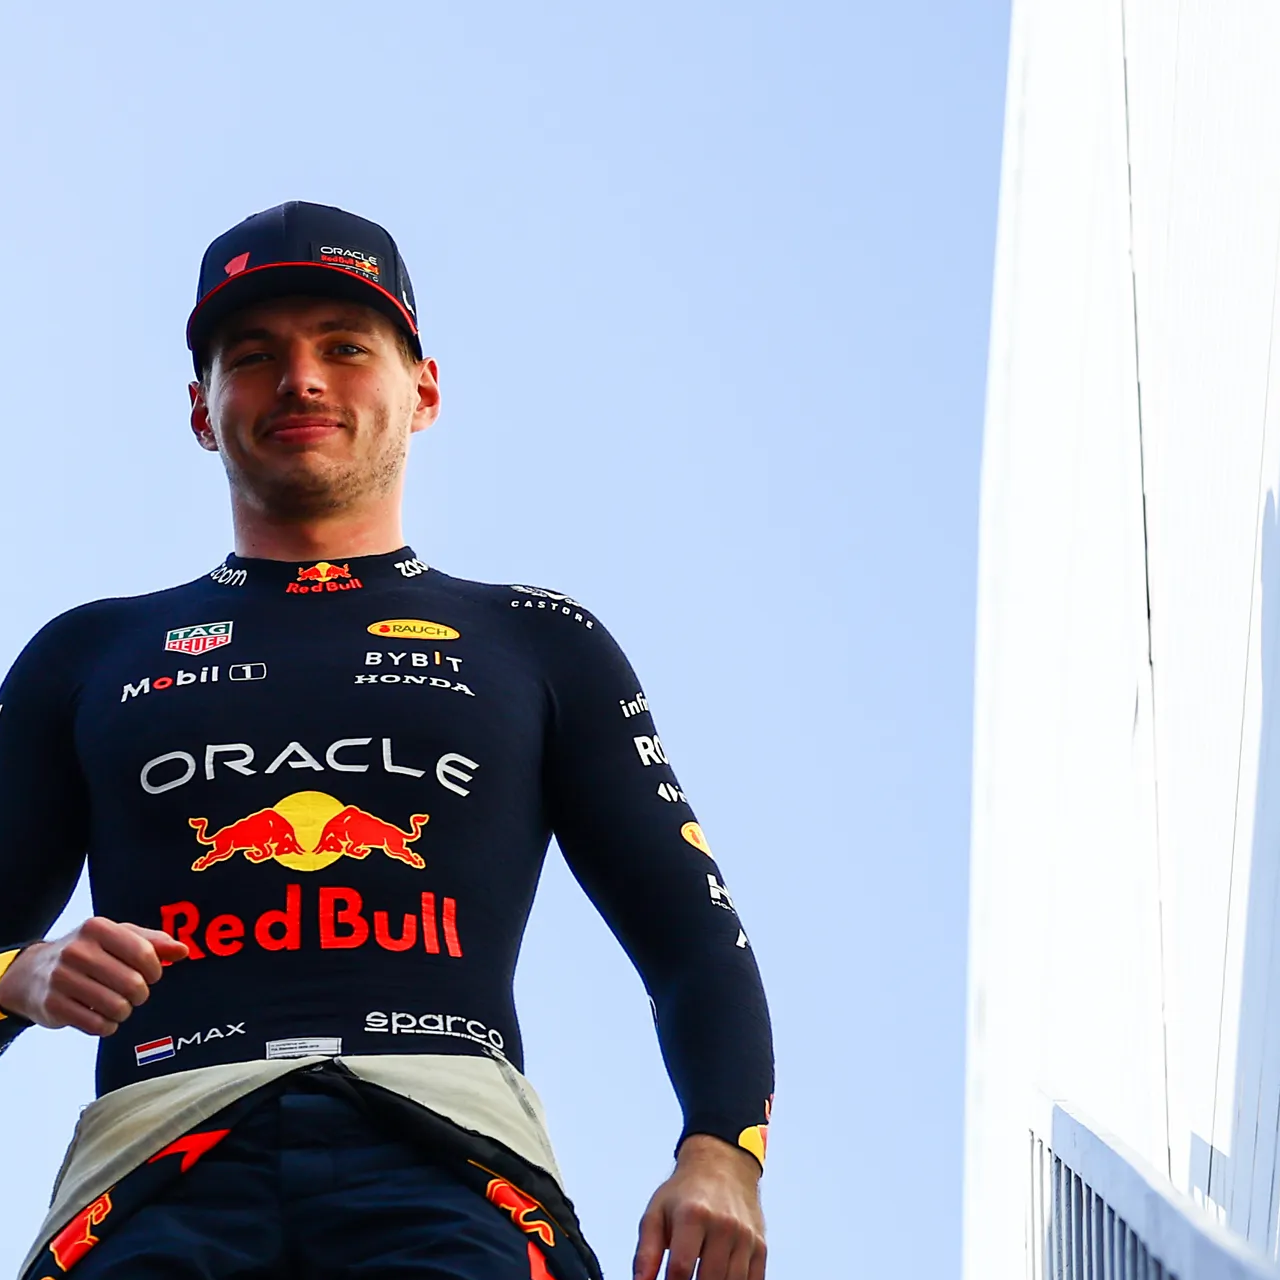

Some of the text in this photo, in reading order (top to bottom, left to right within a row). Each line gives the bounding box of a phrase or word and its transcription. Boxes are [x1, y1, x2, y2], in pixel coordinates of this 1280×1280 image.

[320, 246, 378, 266] ORACLE
[285, 578, 363, 594] Red Bull
[510, 600, 594, 630] CASTORE
[172, 624, 226, 640] TAG
[392, 625, 448, 636] RAUCH
[169, 636, 227, 653] HEUER
[364, 651, 463, 673] BYBIT
[120, 665, 219, 703] Mobil
[354, 674, 476, 697] HONDA
[140, 737, 480, 797] ORACLE
[160, 884, 464, 967] Red Bull
[176, 1022, 246, 1050] MAX
[364, 1011, 505, 1052] sparco
